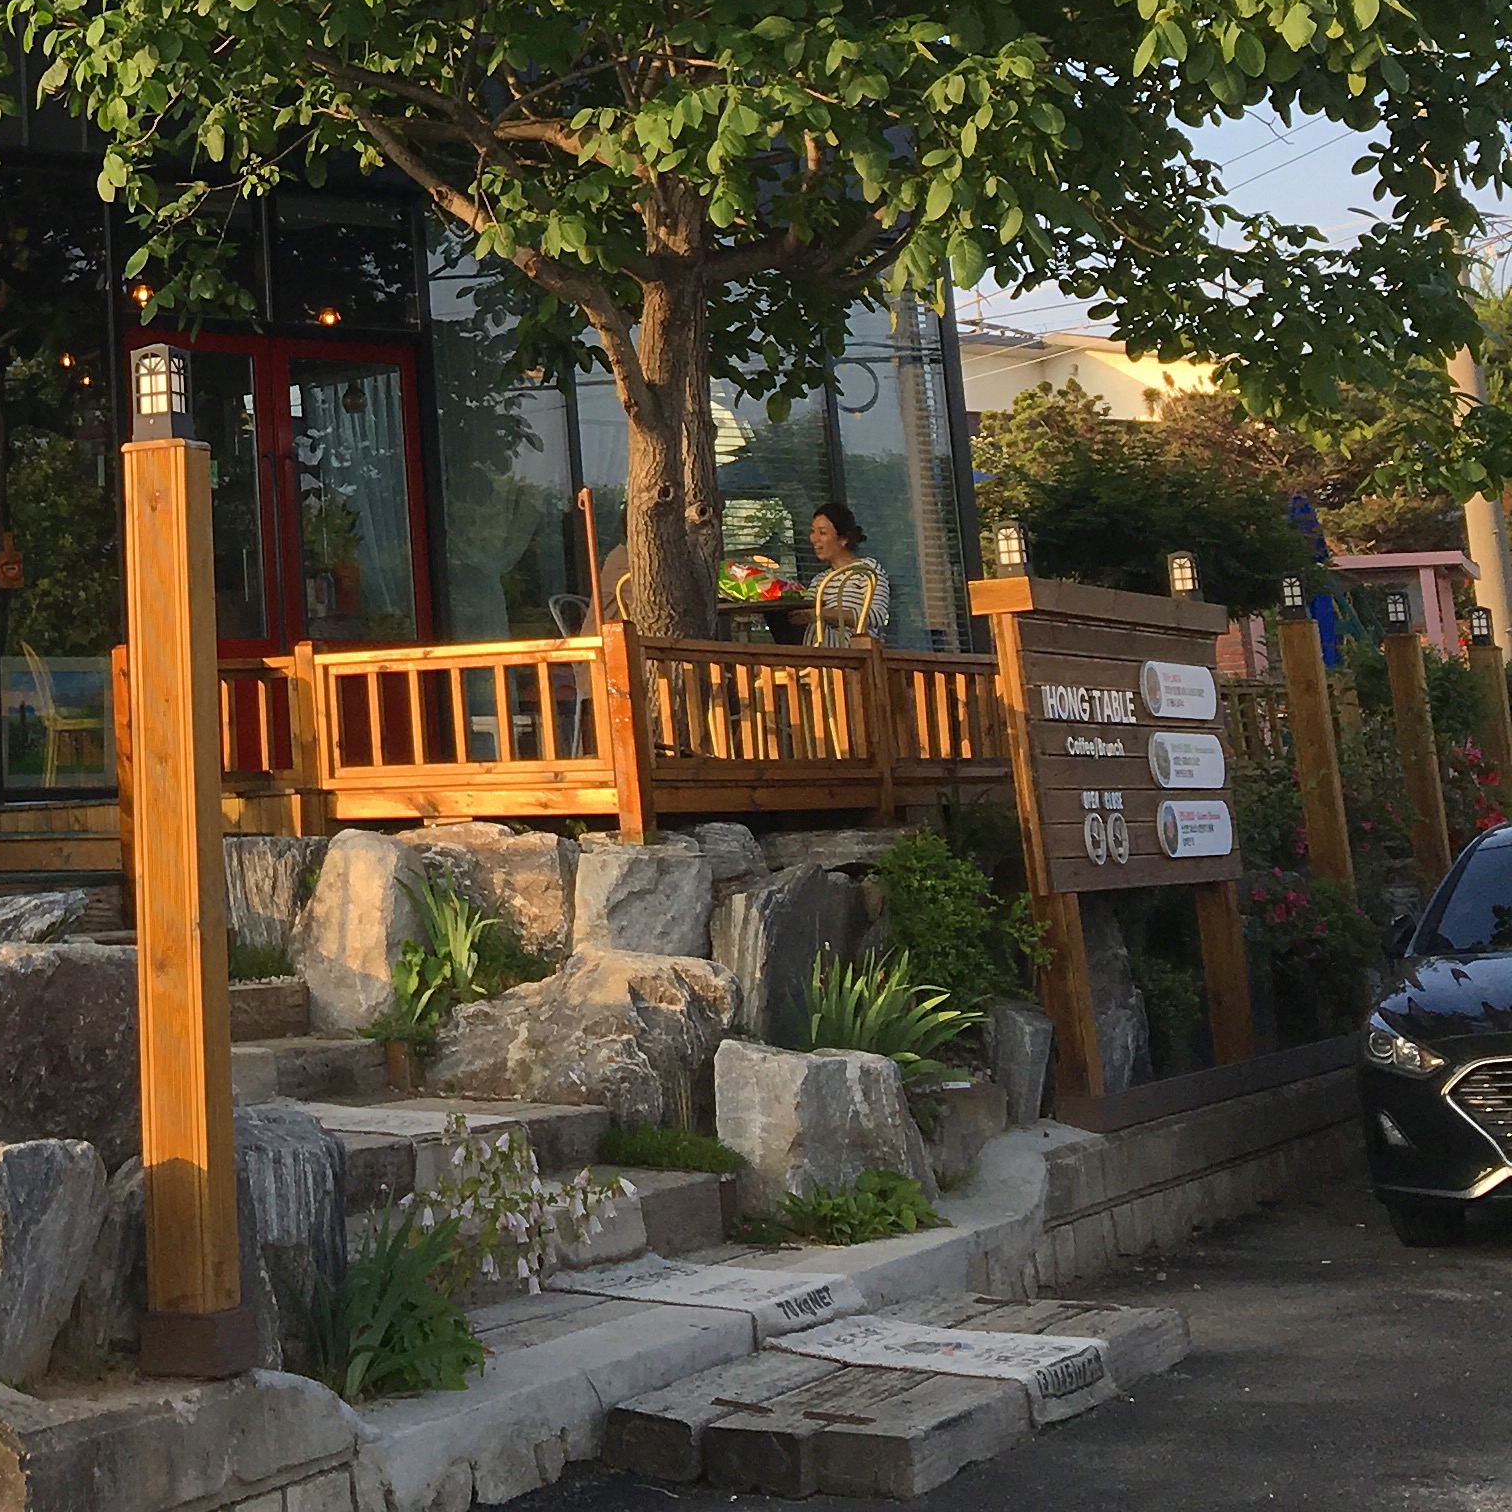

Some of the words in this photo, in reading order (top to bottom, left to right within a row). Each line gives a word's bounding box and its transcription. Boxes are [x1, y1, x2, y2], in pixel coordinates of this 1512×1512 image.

[1041, 685, 1090, 722] HONG
[1091, 690, 1137, 723] TABLE
[1067, 736, 1124, 759] Coffee/Brunch
